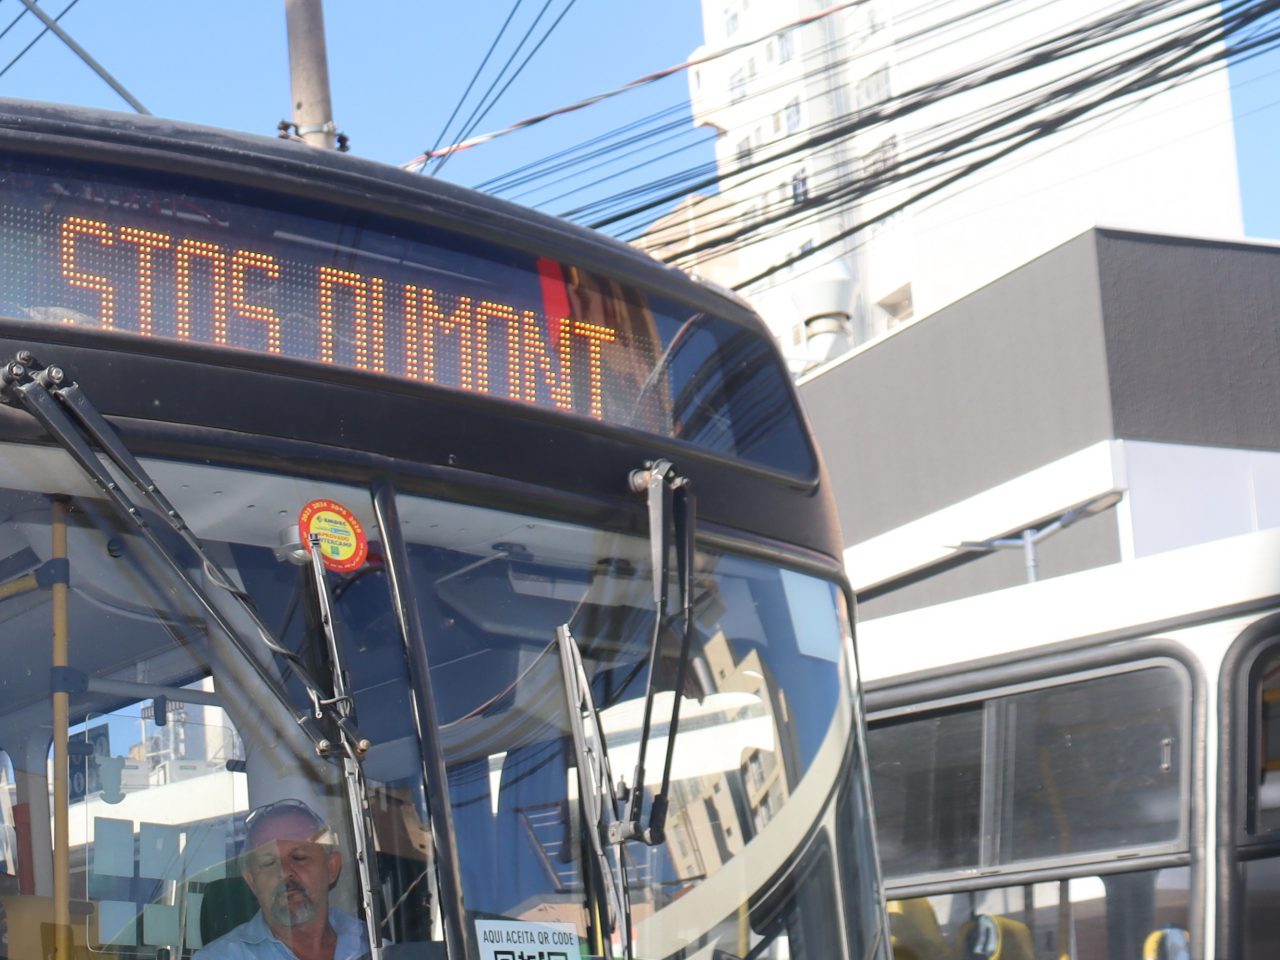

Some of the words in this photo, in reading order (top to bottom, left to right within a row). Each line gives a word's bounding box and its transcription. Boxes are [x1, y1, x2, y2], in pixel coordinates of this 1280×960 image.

[60, 217, 281, 355] STOS
[320, 266, 615, 421] DUMONT
[483, 929, 504, 944] AQUI
[506, 930, 536, 945] ACEITA
[537, 931, 550, 945] QR
[552, 931, 574, 945] CODE
